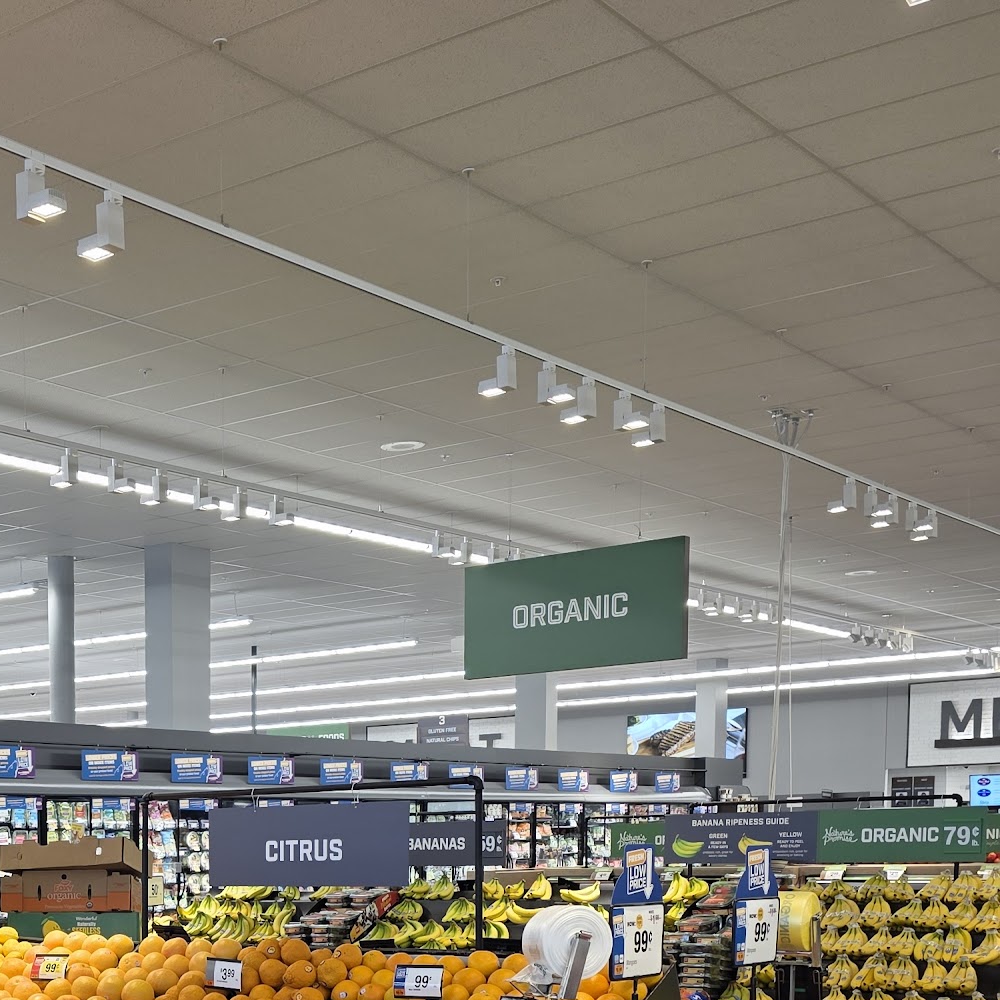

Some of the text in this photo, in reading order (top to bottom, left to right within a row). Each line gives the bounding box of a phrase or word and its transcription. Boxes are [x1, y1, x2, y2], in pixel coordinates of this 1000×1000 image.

[512, 592, 628, 629] ORGANIC
[439, 716, 446, 725] 3
[941, 697, 1000, 740] M
[692, 817, 789, 827] BANANA RIPENESS GUIDE
[824, 826, 855, 837] Nature's
[861, 827, 939, 843] ORGANIC
[943, 826, 980, 846] 79¢
[822, 834, 858, 846] Promise
[265, 838, 343, 863] CITRUS
[628, 853, 645, 864] FRESH
[630, 864, 647, 879] LOW
[750, 863, 764, 876] LOW
[54, 884, 74, 893] FOXY
[630, 877, 647, 891] PRICE
[750, 876, 765, 888] PRICE
[47, 890, 81, 902] organic
[72, 927, 101, 935] SEEDLESS
[754, 922, 770, 943] 99¢
[634, 930, 652, 953] 99¢
[414, 975, 432, 988] 99¢
